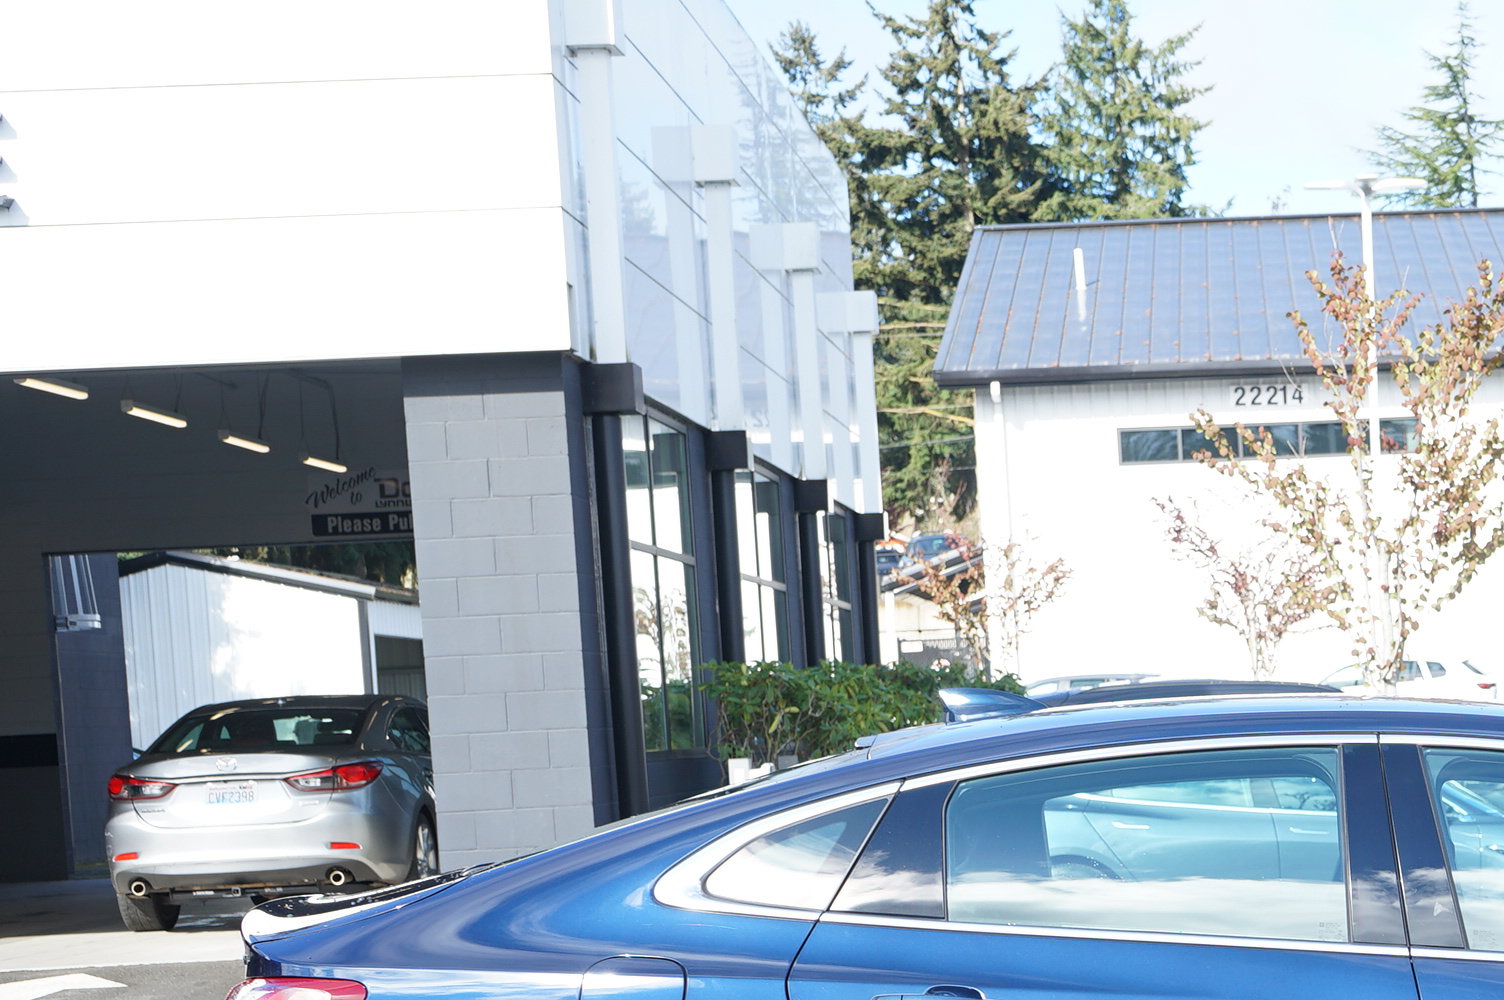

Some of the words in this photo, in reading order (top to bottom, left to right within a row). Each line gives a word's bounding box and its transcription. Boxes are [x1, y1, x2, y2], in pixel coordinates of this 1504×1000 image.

[1234, 384, 1304, 406] 22214
[304, 466, 376, 508] Welcome
[350, 491, 363, 505] to
[327, 514, 381, 533] Please
[208, 790, 255, 804] CVF2398
